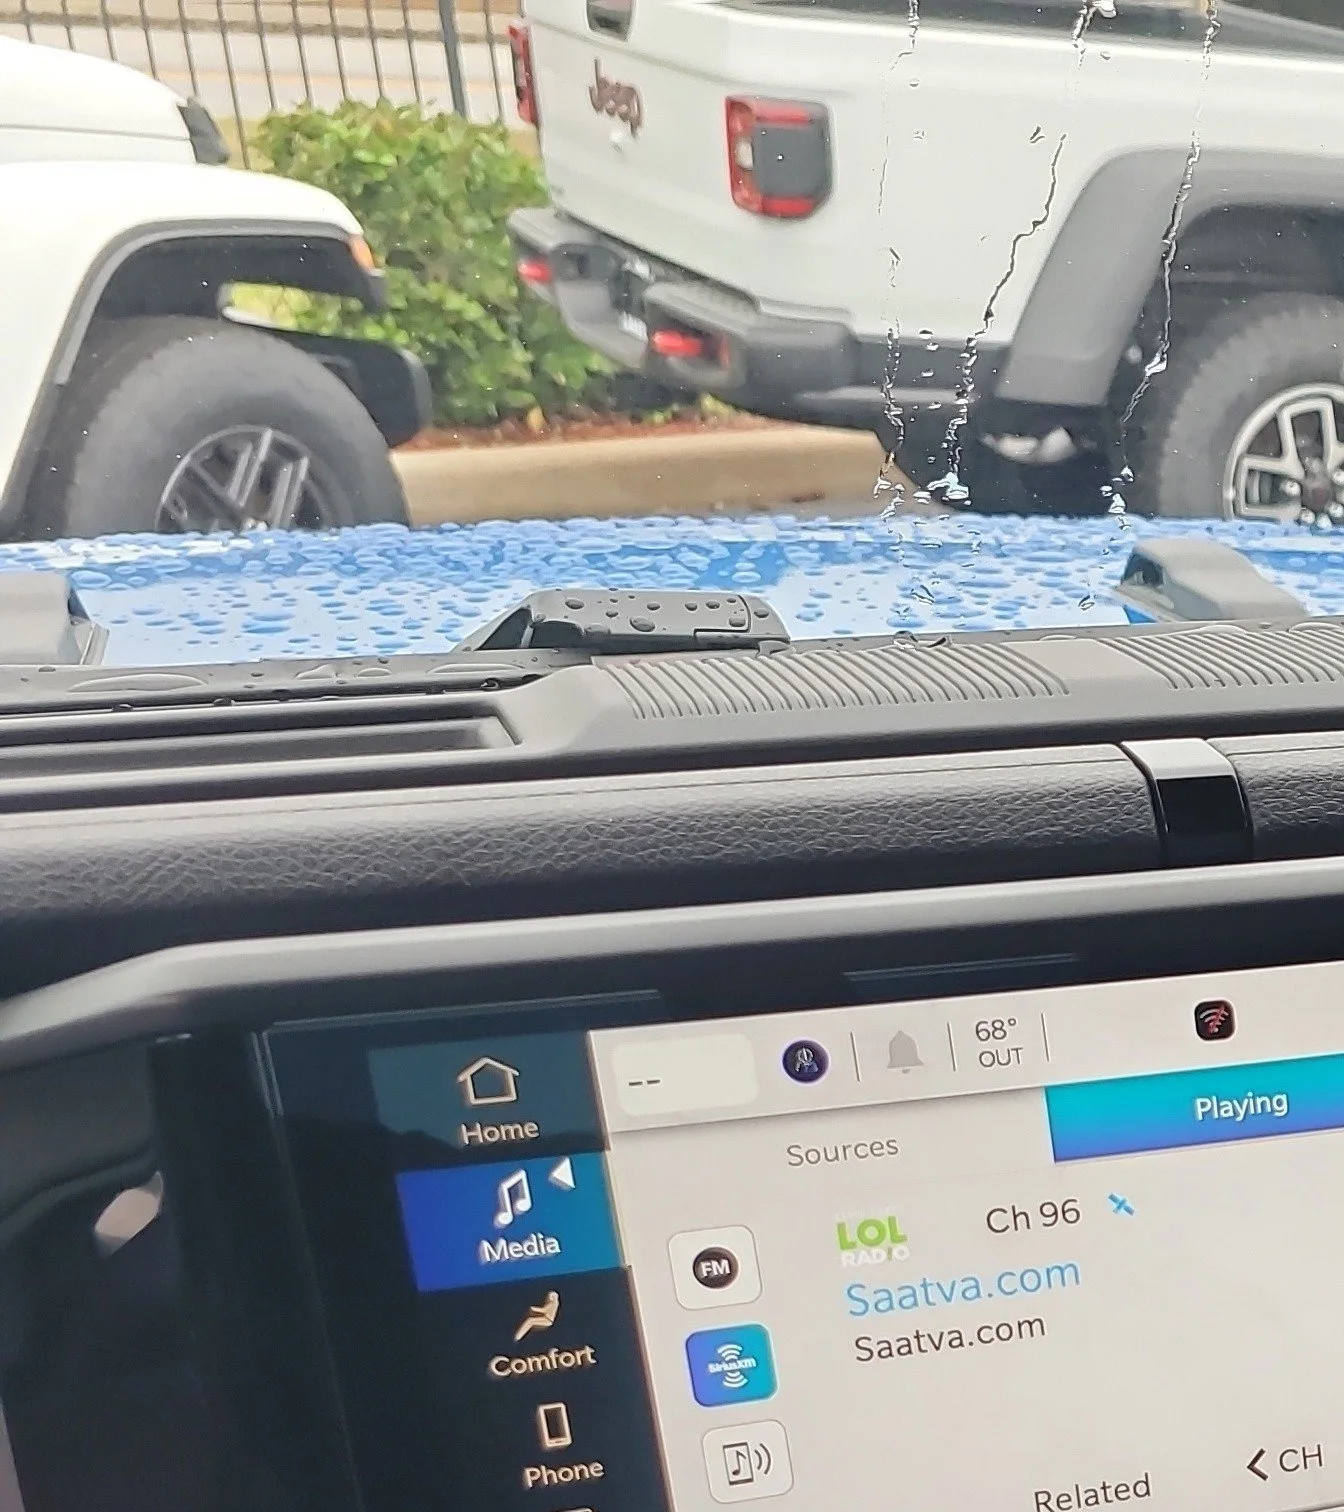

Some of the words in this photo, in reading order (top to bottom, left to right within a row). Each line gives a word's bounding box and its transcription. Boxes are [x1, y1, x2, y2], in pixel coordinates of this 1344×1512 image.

[975, 1017, 1018, 1043] 68°
[978, 1046, 1023, 1069] OUT
[1194, 1089, 1289, 1122] Playing
[460, 1118, 540, 1145] Home
[786, 1134, 900, 1168] Sources
[986, 1205, 1031, 1234] Ch
[1039, 1198, 1082, 1227] 96
[479, 1232, 562, 1264] Media
[836, 1215, 909, 1250] LOL
[700, 1258, 731, 1278] FM
[846, 1261, 1081, 1317] Saatva.com
[854, 1316, 1046, 1362] Saatva.com
[489, 1343, 597, 1380] Comfort
[523, 1458, 605, 1489] Phone
[1278, 1443, 1325, 1473] CH
